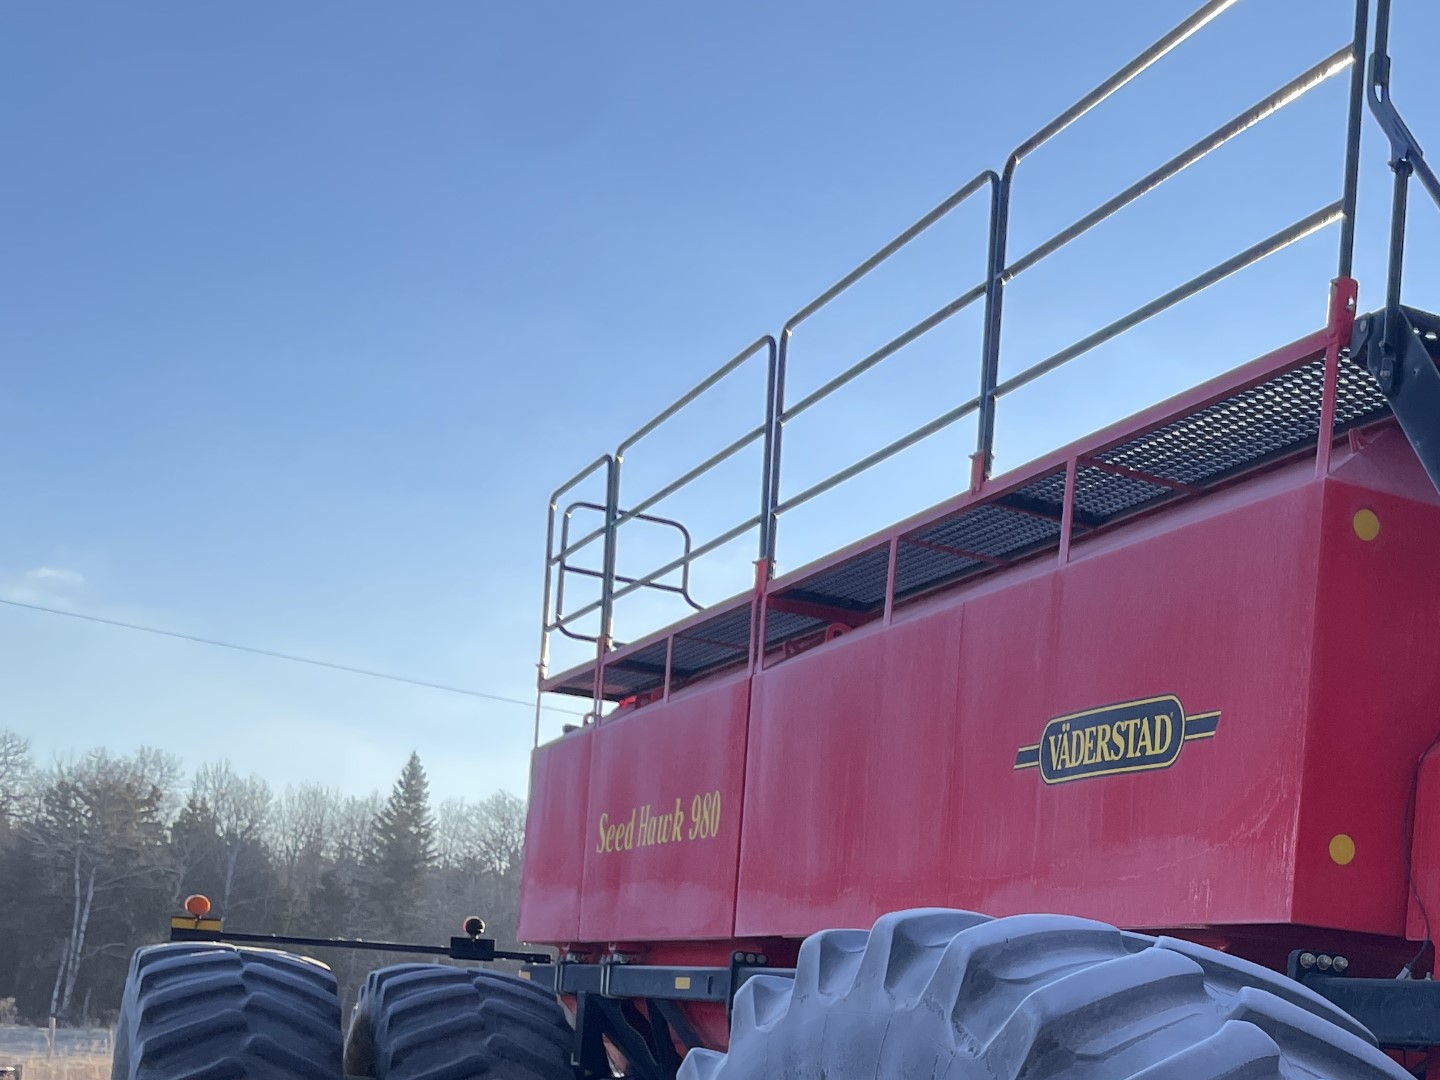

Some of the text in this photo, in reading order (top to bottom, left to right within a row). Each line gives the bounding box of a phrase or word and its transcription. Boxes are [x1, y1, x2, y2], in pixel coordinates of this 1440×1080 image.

[1048, 713, 1174, 771] VÄDERSTAD
[596, 790, 721, 853] Seed Hawk 980
